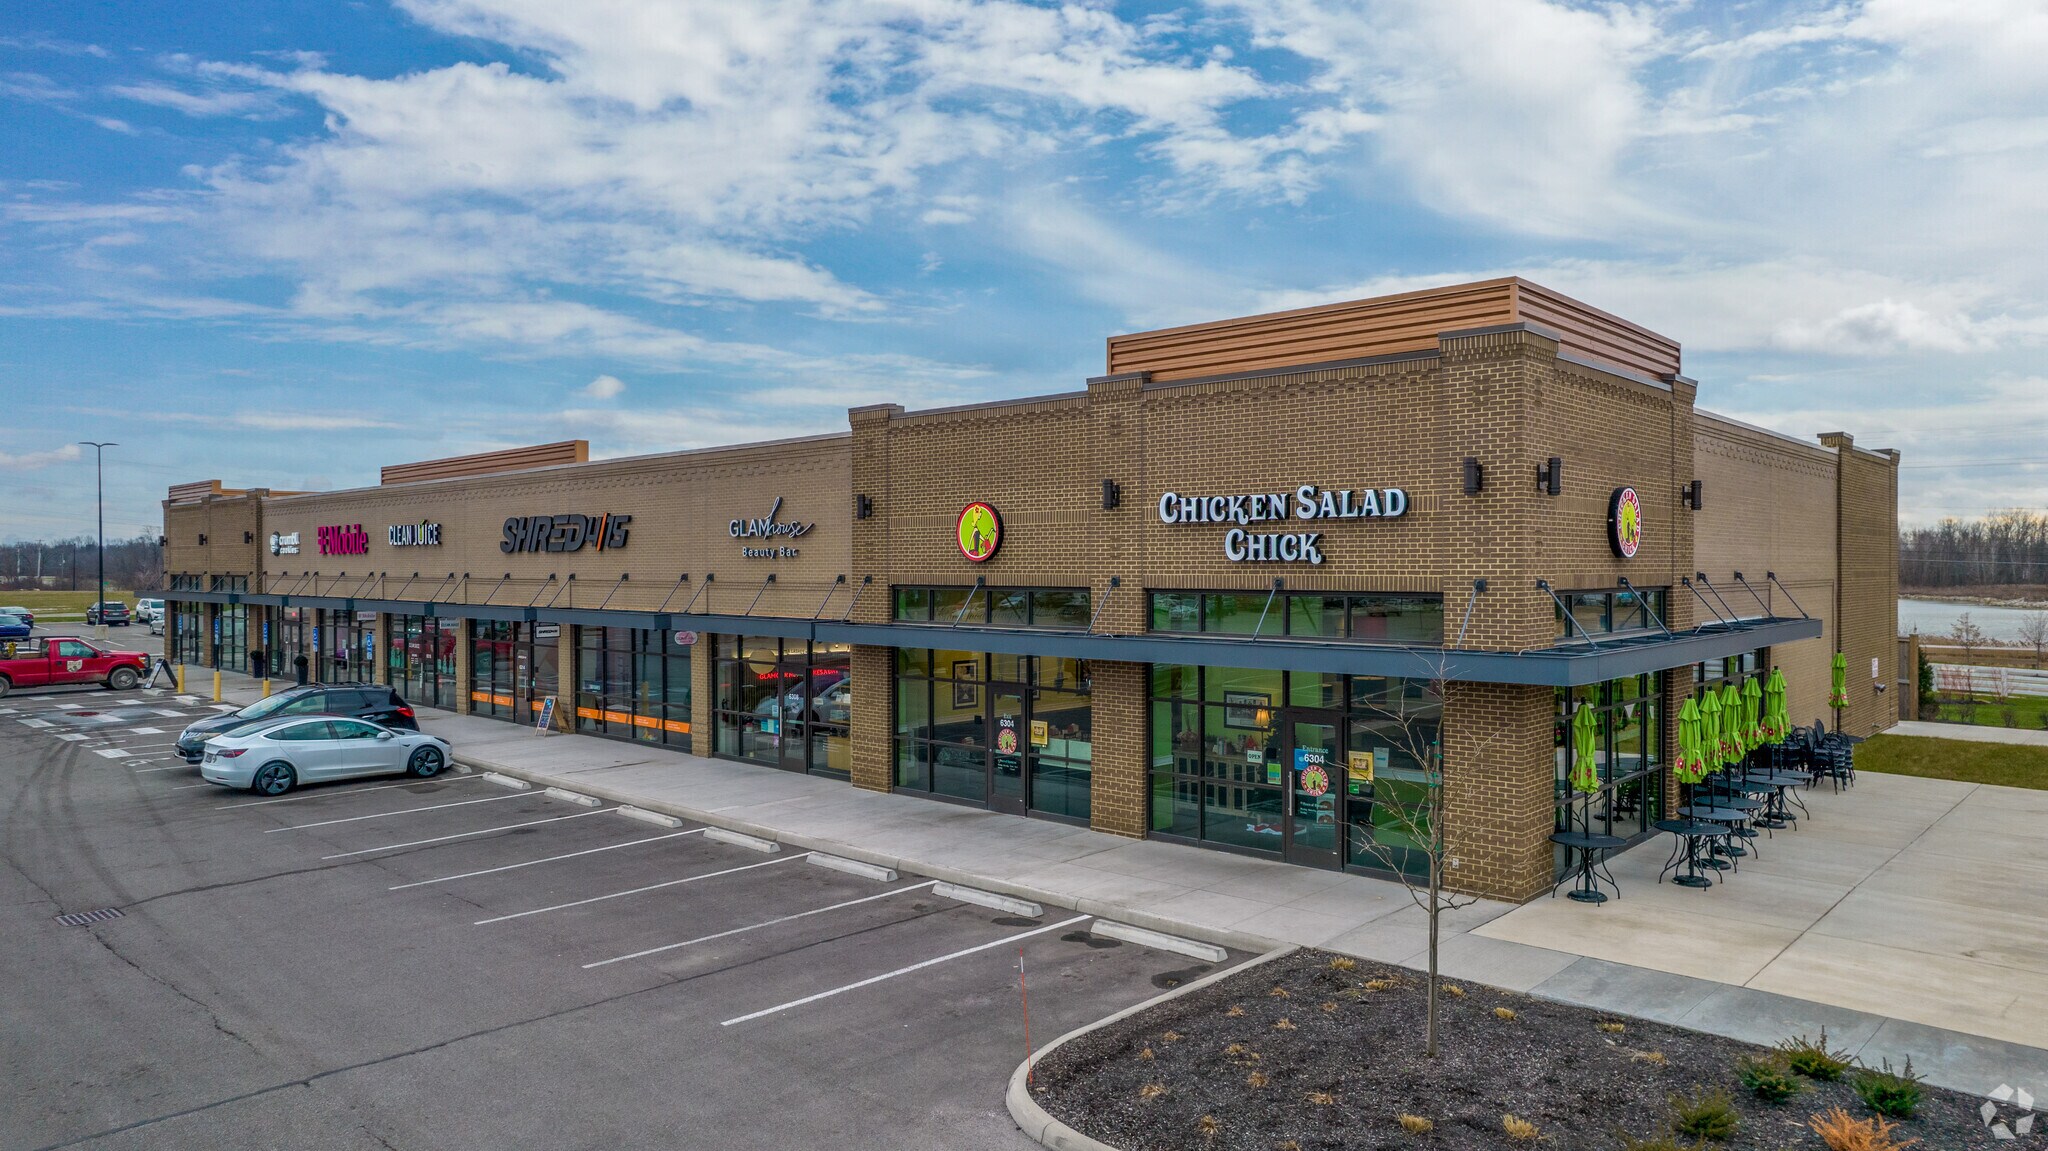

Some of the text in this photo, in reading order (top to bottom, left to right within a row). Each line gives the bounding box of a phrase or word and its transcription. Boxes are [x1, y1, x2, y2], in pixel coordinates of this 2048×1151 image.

[1159, 485, 1409, 525] CHICKEN SALAD
[388, 525, 412, 546] CLEAN
[742, 546, 797, 560] Beauty Bar
[1225, 528, 1323, 565] CHICK
[1000, 719, 1014, 727] 6304
[1302, 745, 1329, 754] Entrance
[1303, 753, 1325, 764] 6304
